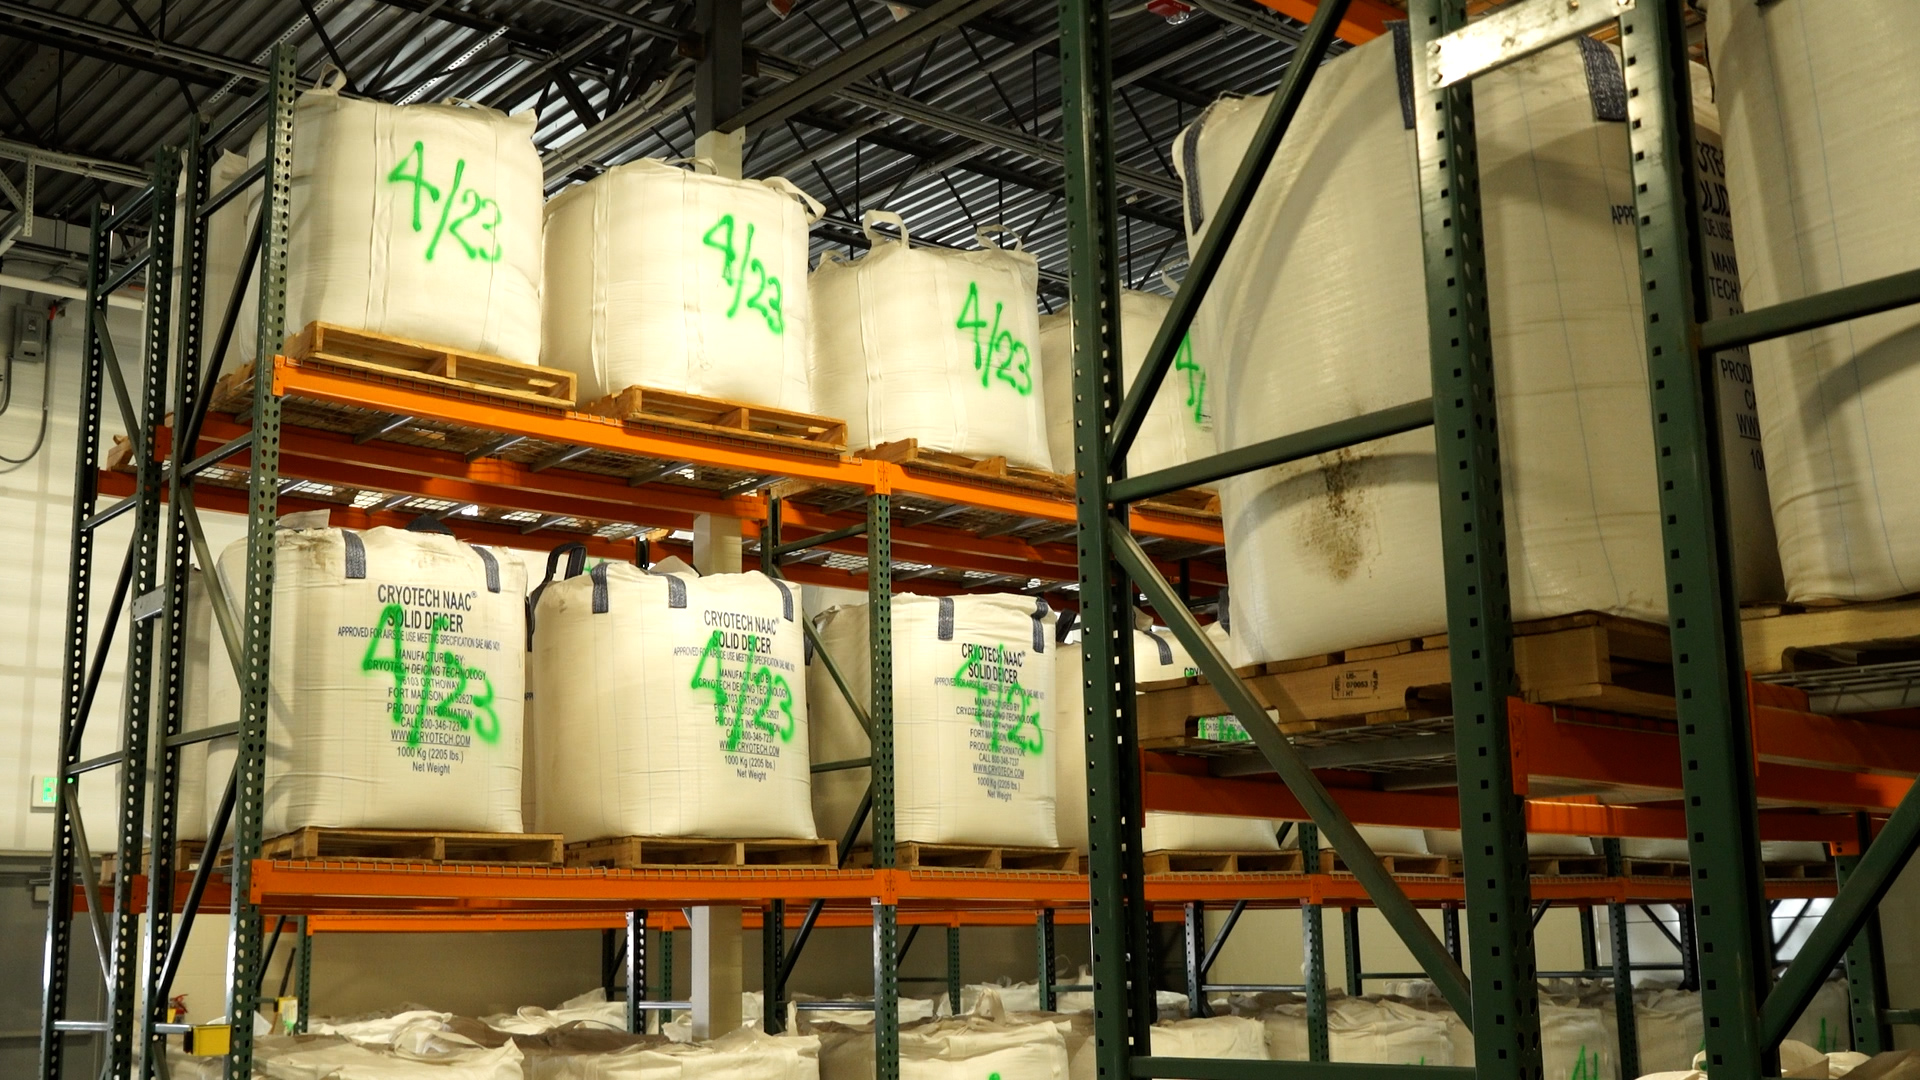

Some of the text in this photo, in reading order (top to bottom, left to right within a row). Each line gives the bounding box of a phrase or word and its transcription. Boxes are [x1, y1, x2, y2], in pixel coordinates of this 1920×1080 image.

[388, 140, 502, 263] 4/23
[703, 214, 785, 336] 4/23
[956, 281, 1033, 396] 4/23
[378, 583, 440, 608] CRYOTECH
[387, 607, 463, 633] SOLID DEICER
[704, 609, 753, 631] CRYOTECH
[337, 626, 369, 638] APPROVED
[382, 629, 405, 641] AIRSE
[405, 631, 417, 642] USE
[440, 633, 475, 648] SPECIFICATION
[712, 630, 771, 654] SOLID DEICER
[961, 642, 1002, 664] CRYOTECH
[362, 602, 501, 747] 4/23
[411, 662, 441, 677] DEICING
[442, 664, 487, 681] TECHNOLOGY
[719, 668, 764, 684] MANUFACTURD
[968, 662, 1018, 685] SOLID DEICER
[387, 687, 410, 699] FORT
[690, 629, 795, 752] 4/23
[387, 702, 474, 720] PRODUCT INFRMATION:
[400, 717, 419, 729] CALL
[390, 729, 471, 746] WWWCRYOTECH.COM
[396, 746, 416, 758] 1000
[416, 747, 428, 761] Kg
[428, 748, 449, 760] (2205
[725, 754, 739, 765] 1000
[740, 755, 748, 768] Kg
[412, 761, 450, 776] Net Weight
[737, 768, 767, 782] Net Weight
